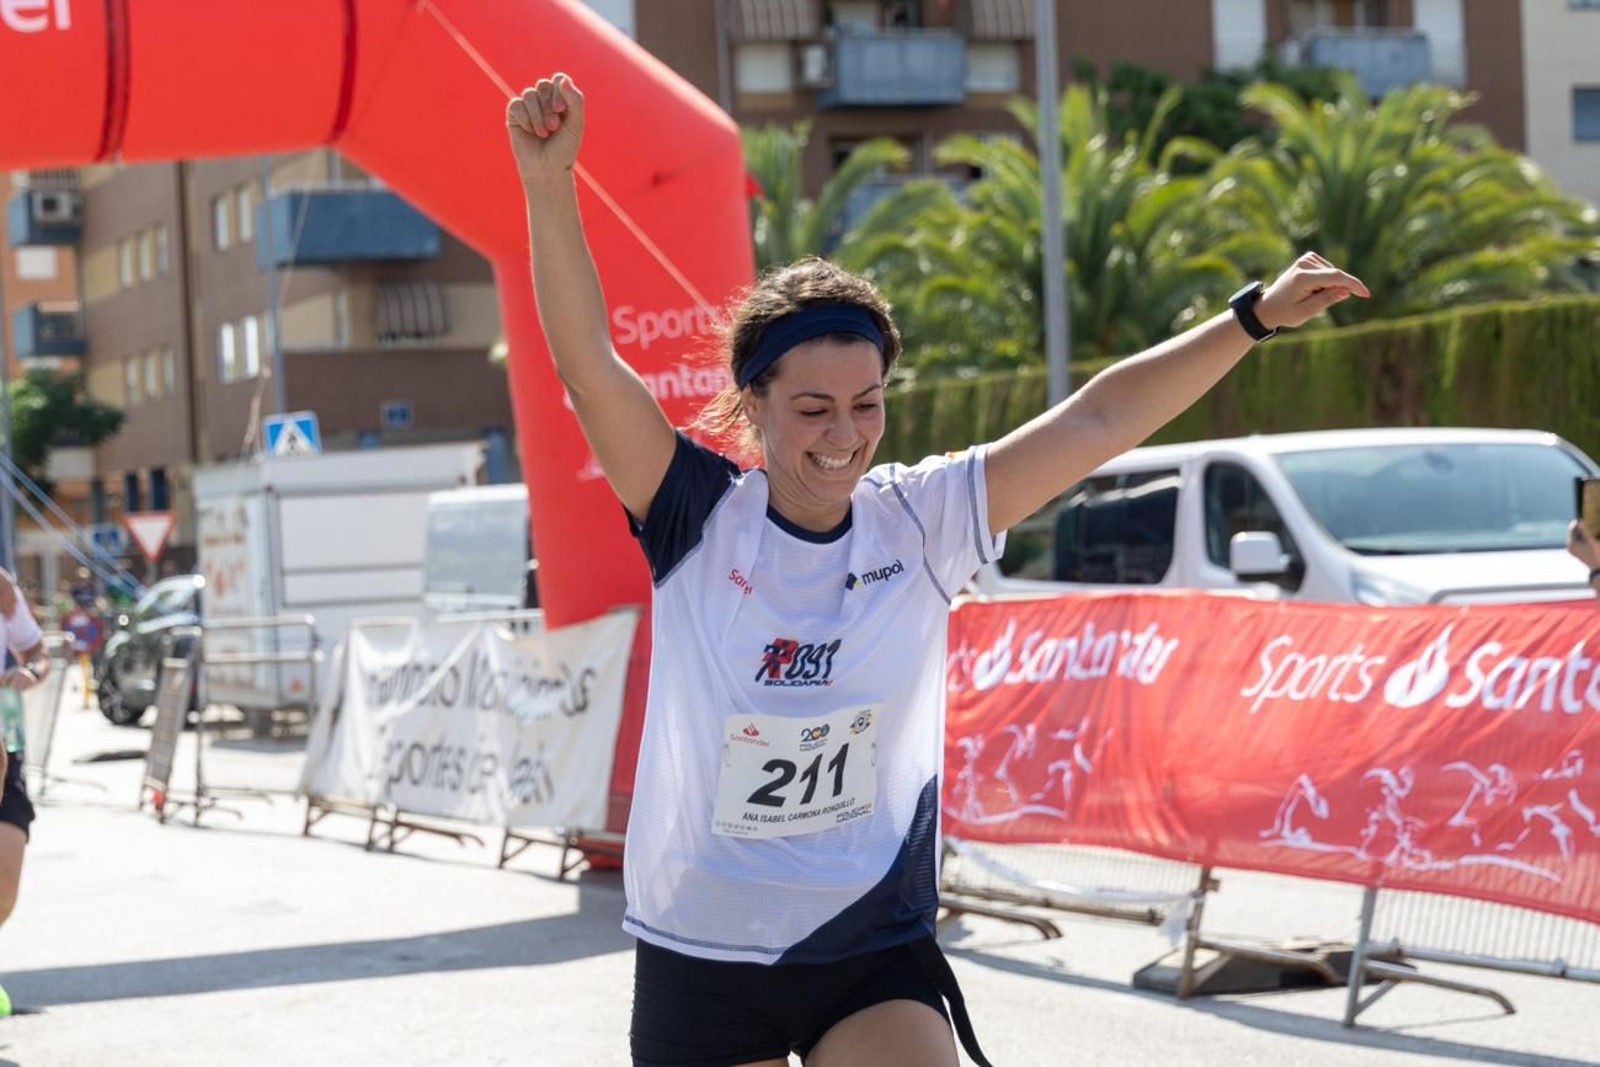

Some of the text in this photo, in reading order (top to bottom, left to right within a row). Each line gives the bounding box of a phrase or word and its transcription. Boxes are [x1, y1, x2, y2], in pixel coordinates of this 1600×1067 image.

[1241, 634, 1386, 713] Sports
[747, 742, 849, 807] 211
[742, 812, 758, 821] ANA
[760, 815, 786, 823] ISABEL
[788, 809, 821, 821] CARMONA
